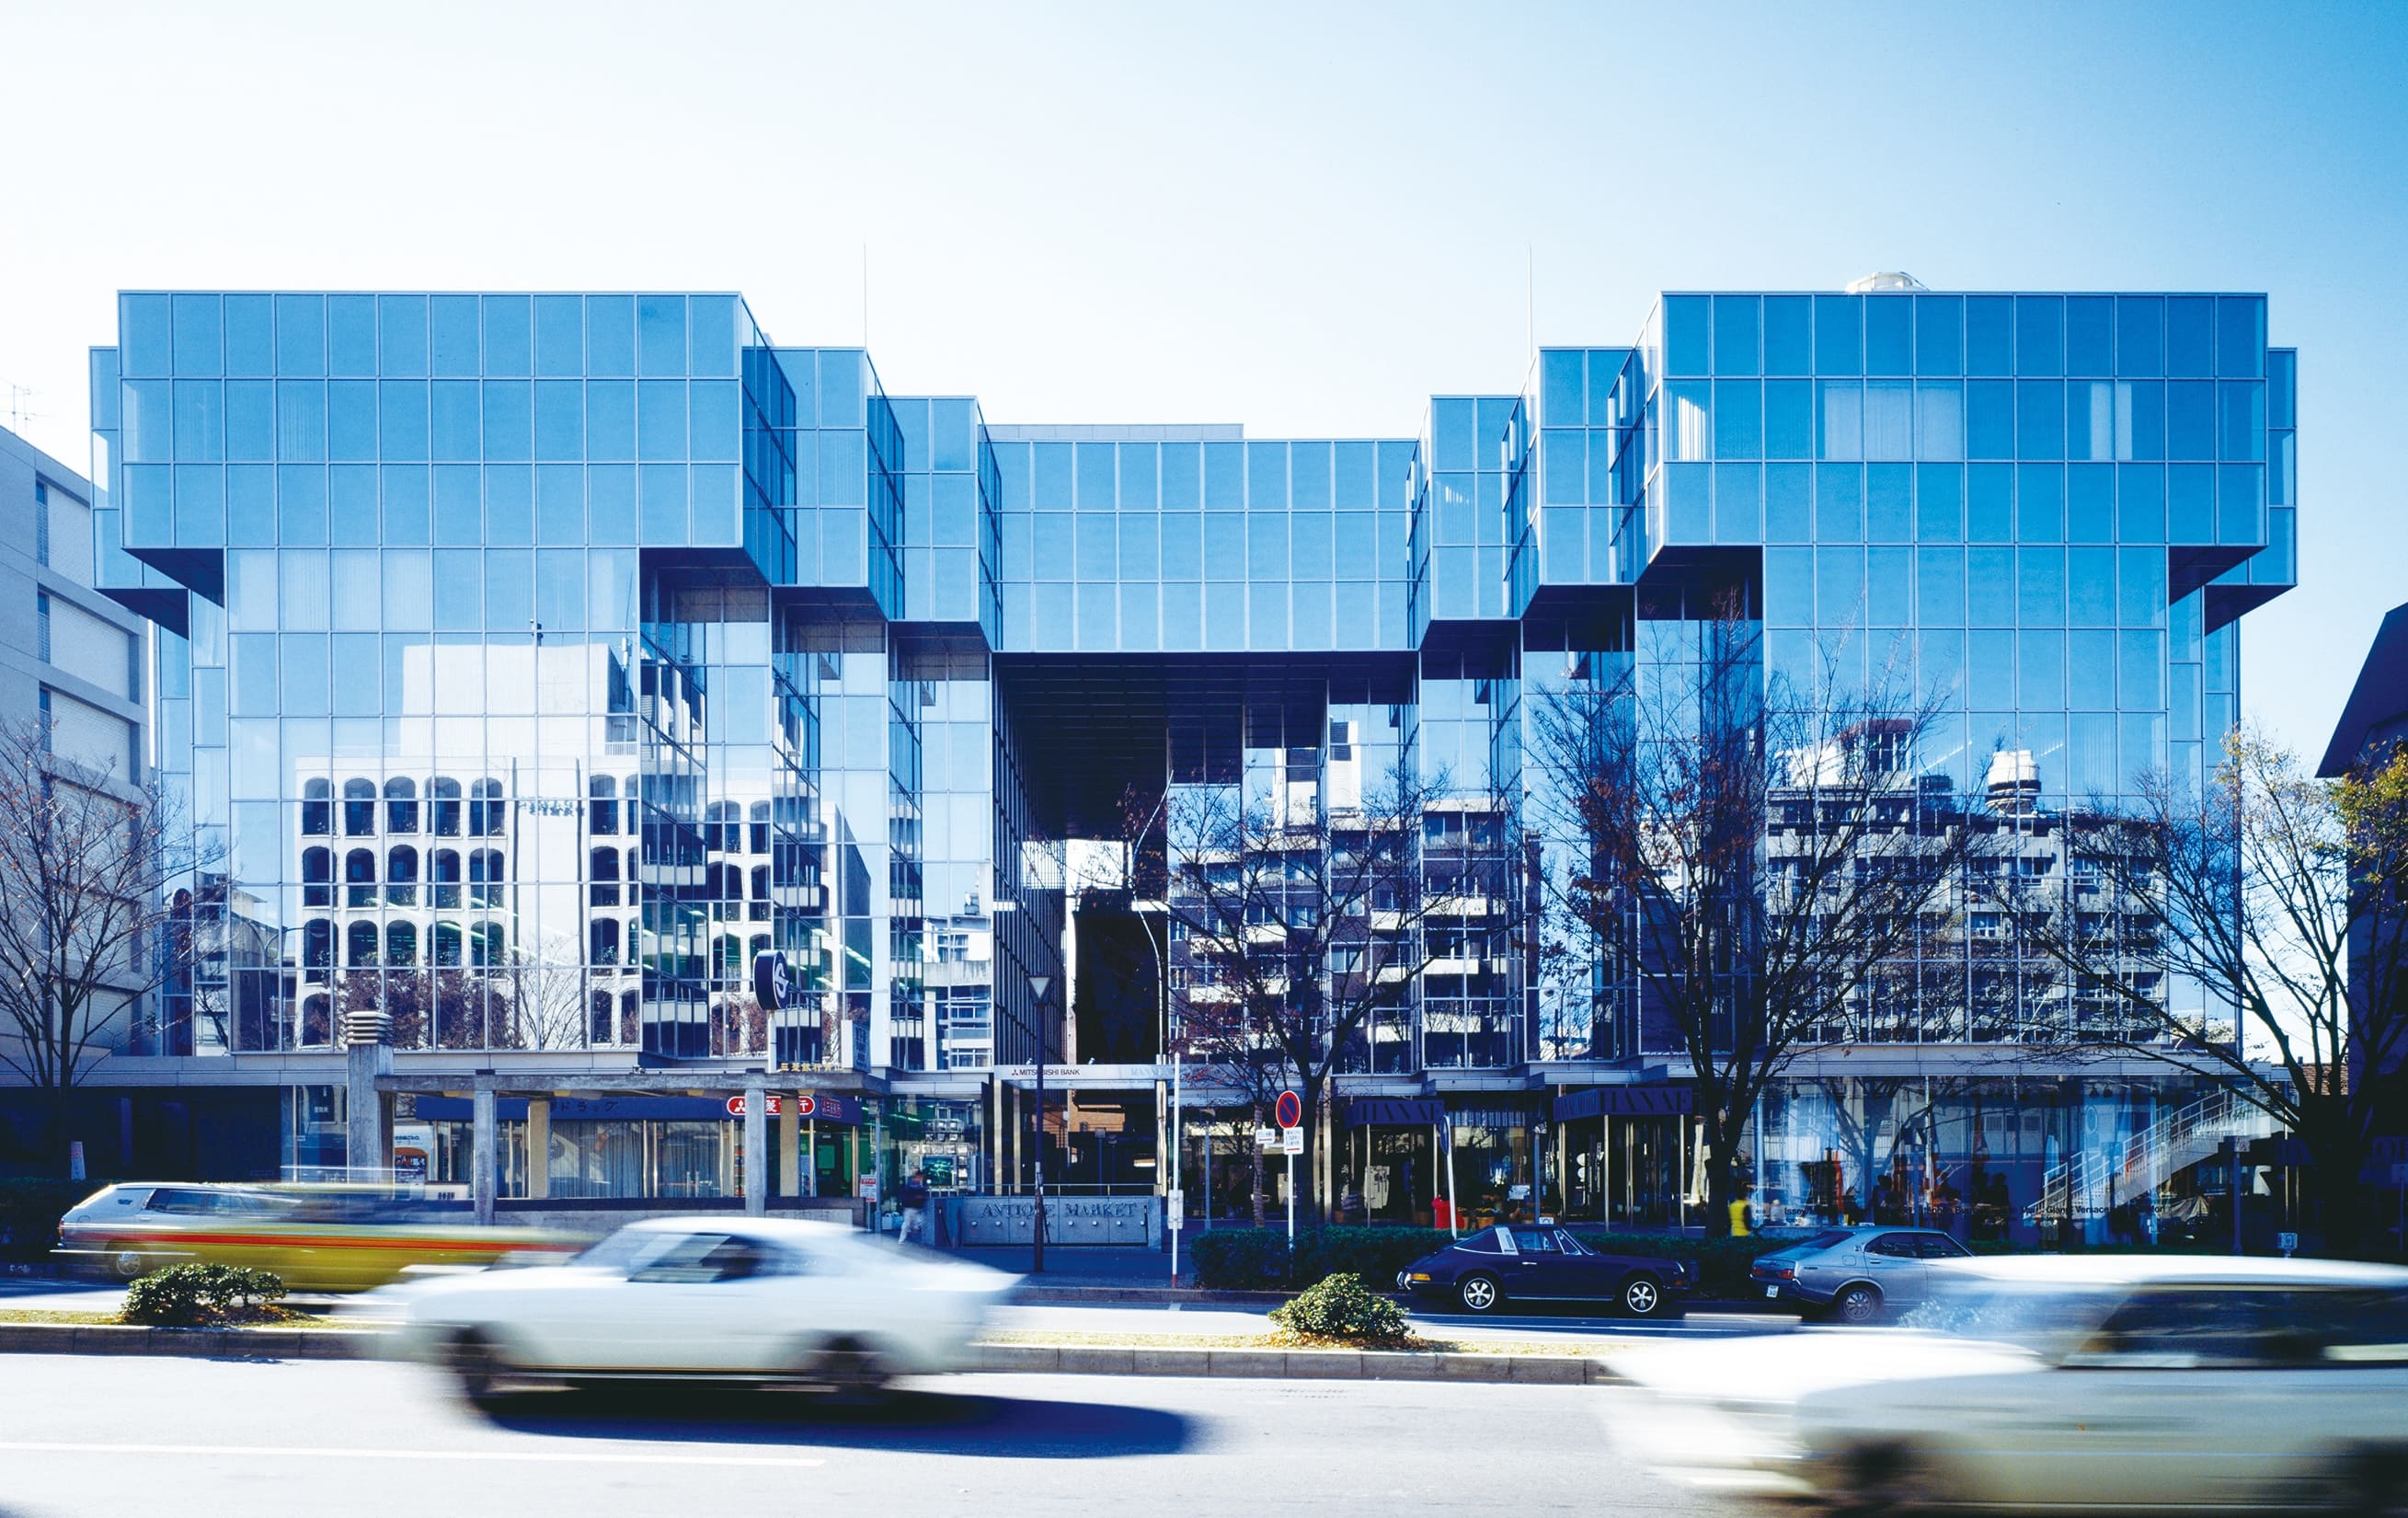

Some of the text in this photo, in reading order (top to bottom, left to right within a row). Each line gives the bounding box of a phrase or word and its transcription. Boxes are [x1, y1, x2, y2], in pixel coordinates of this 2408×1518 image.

[982, 1203, 1137, 1218] ANTIQE MARKET
[2075, 1205, 2110, 1213] Versace
